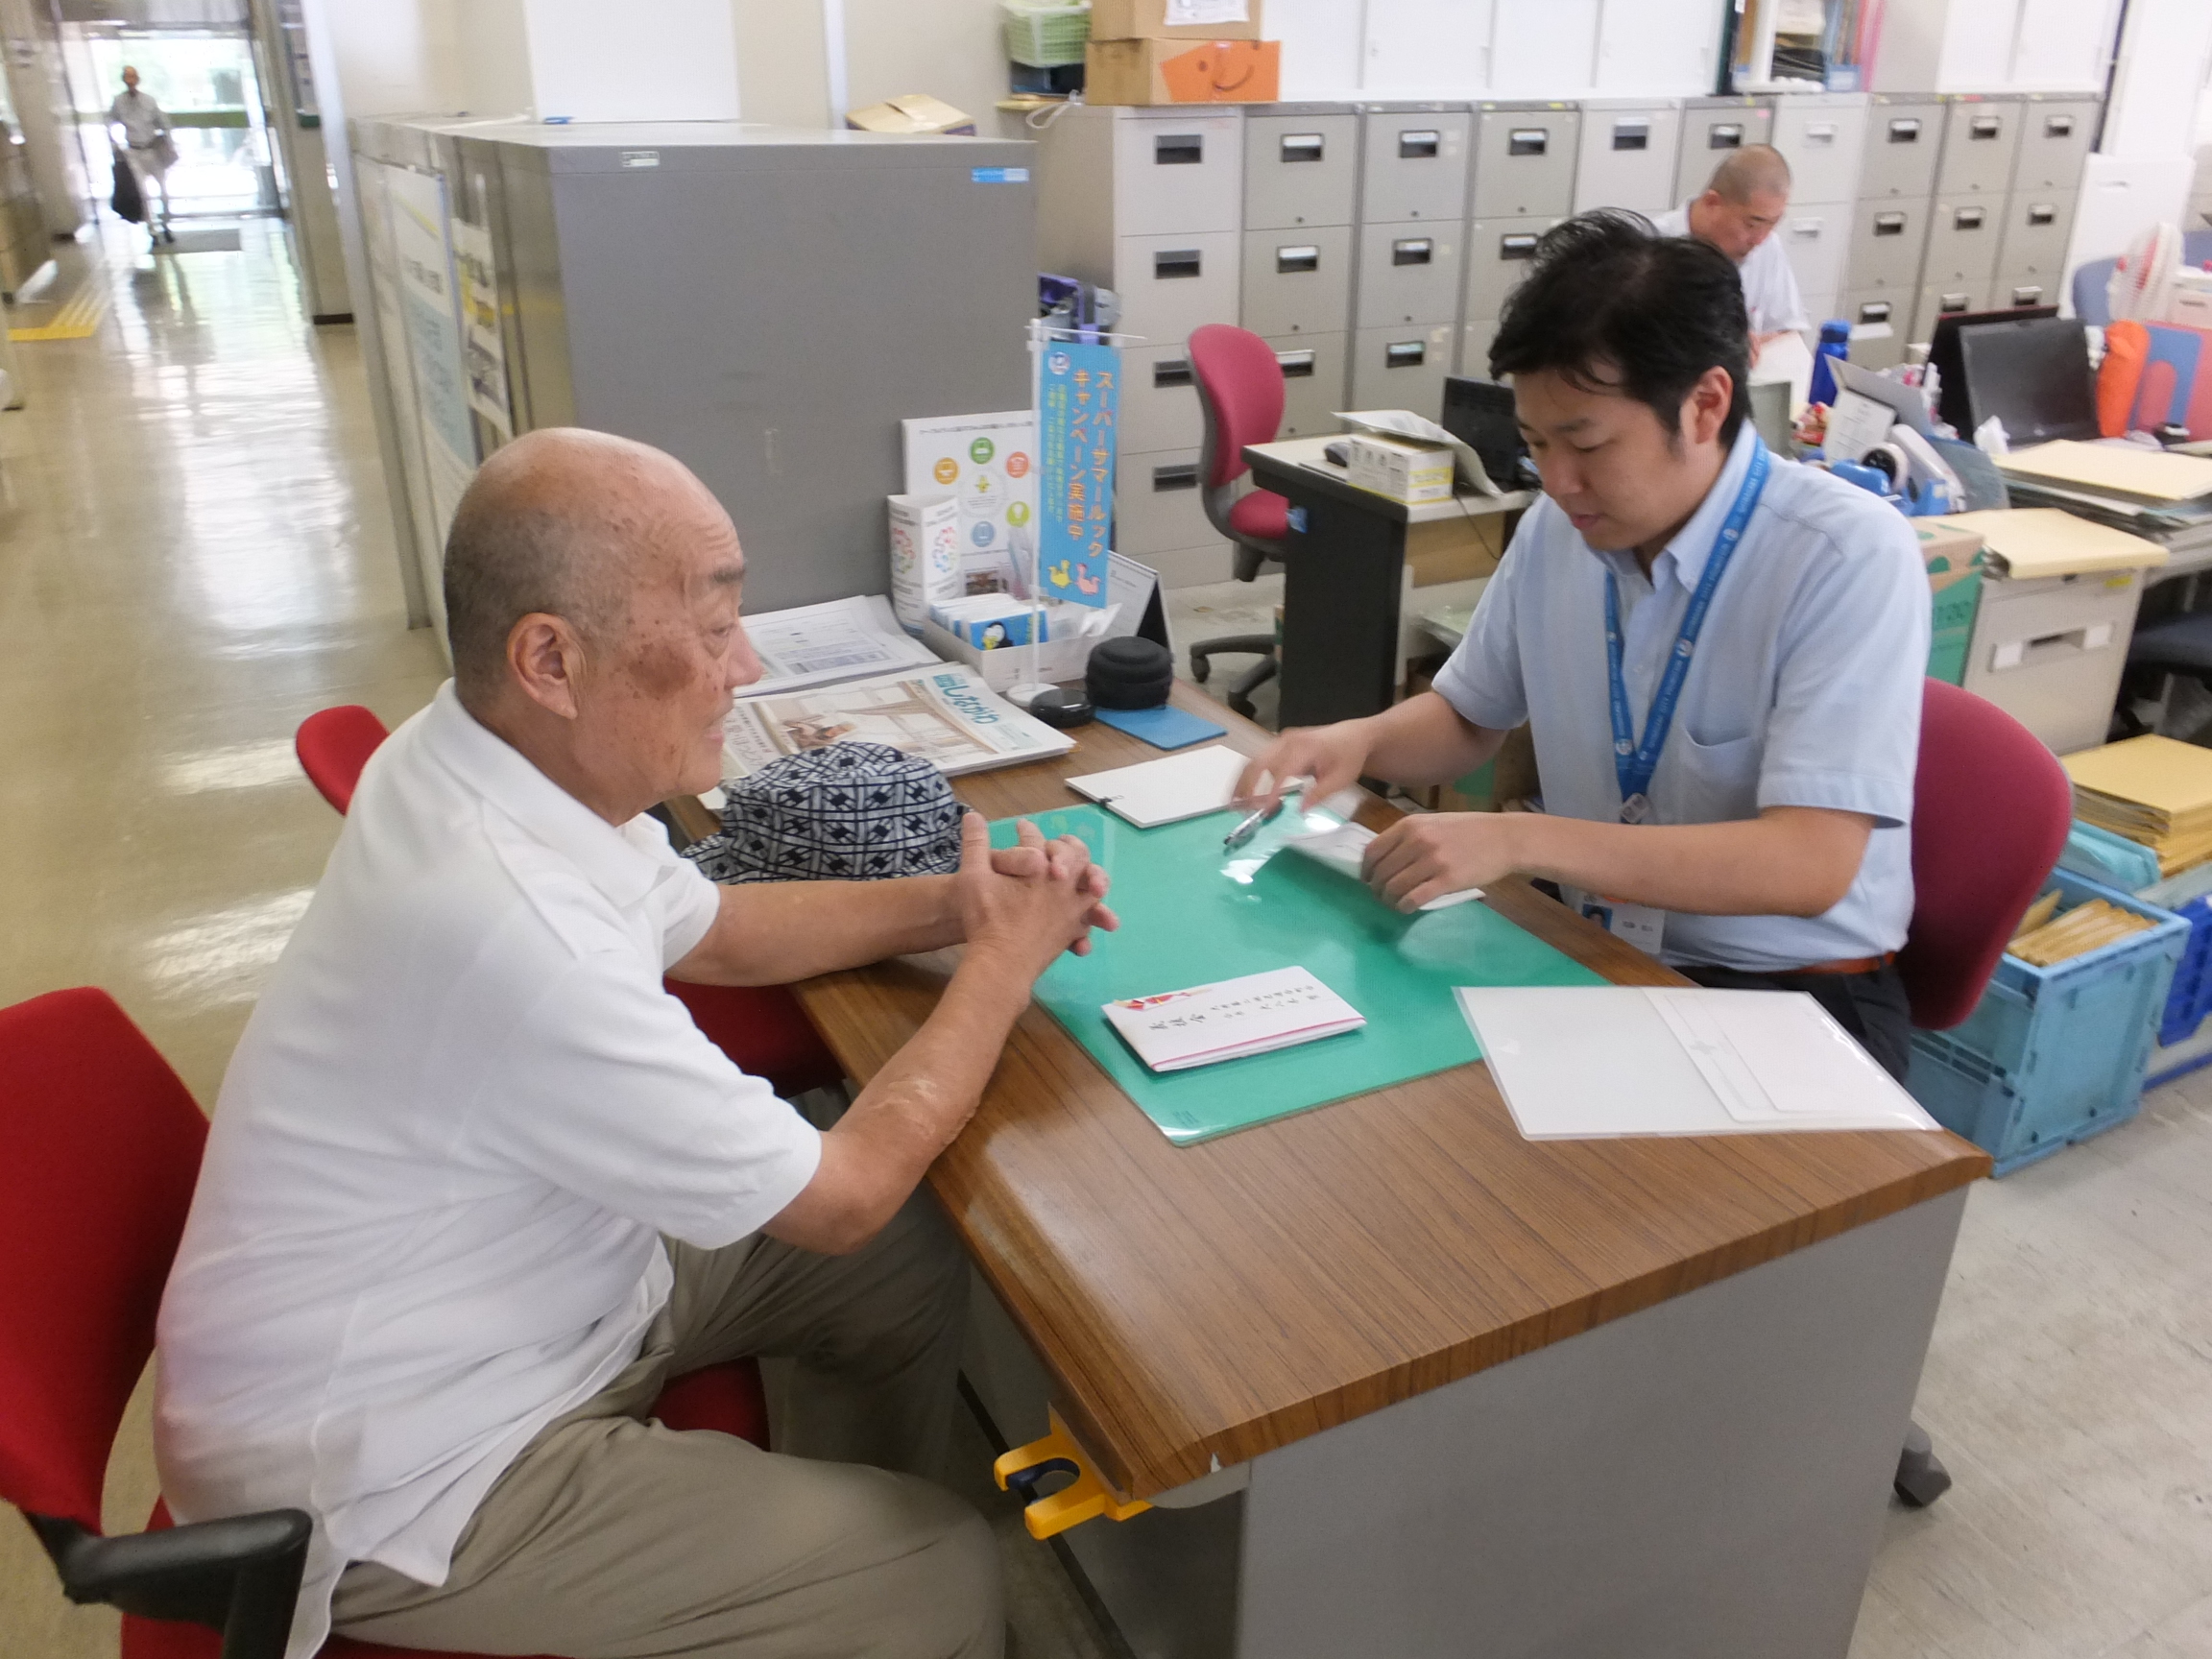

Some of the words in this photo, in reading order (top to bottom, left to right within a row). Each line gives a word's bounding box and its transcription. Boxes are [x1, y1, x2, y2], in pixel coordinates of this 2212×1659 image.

[1068, 369, 1091, 541] キャンペーン実施中
[1088, 372, 1114, 557] スーパーサマールック
